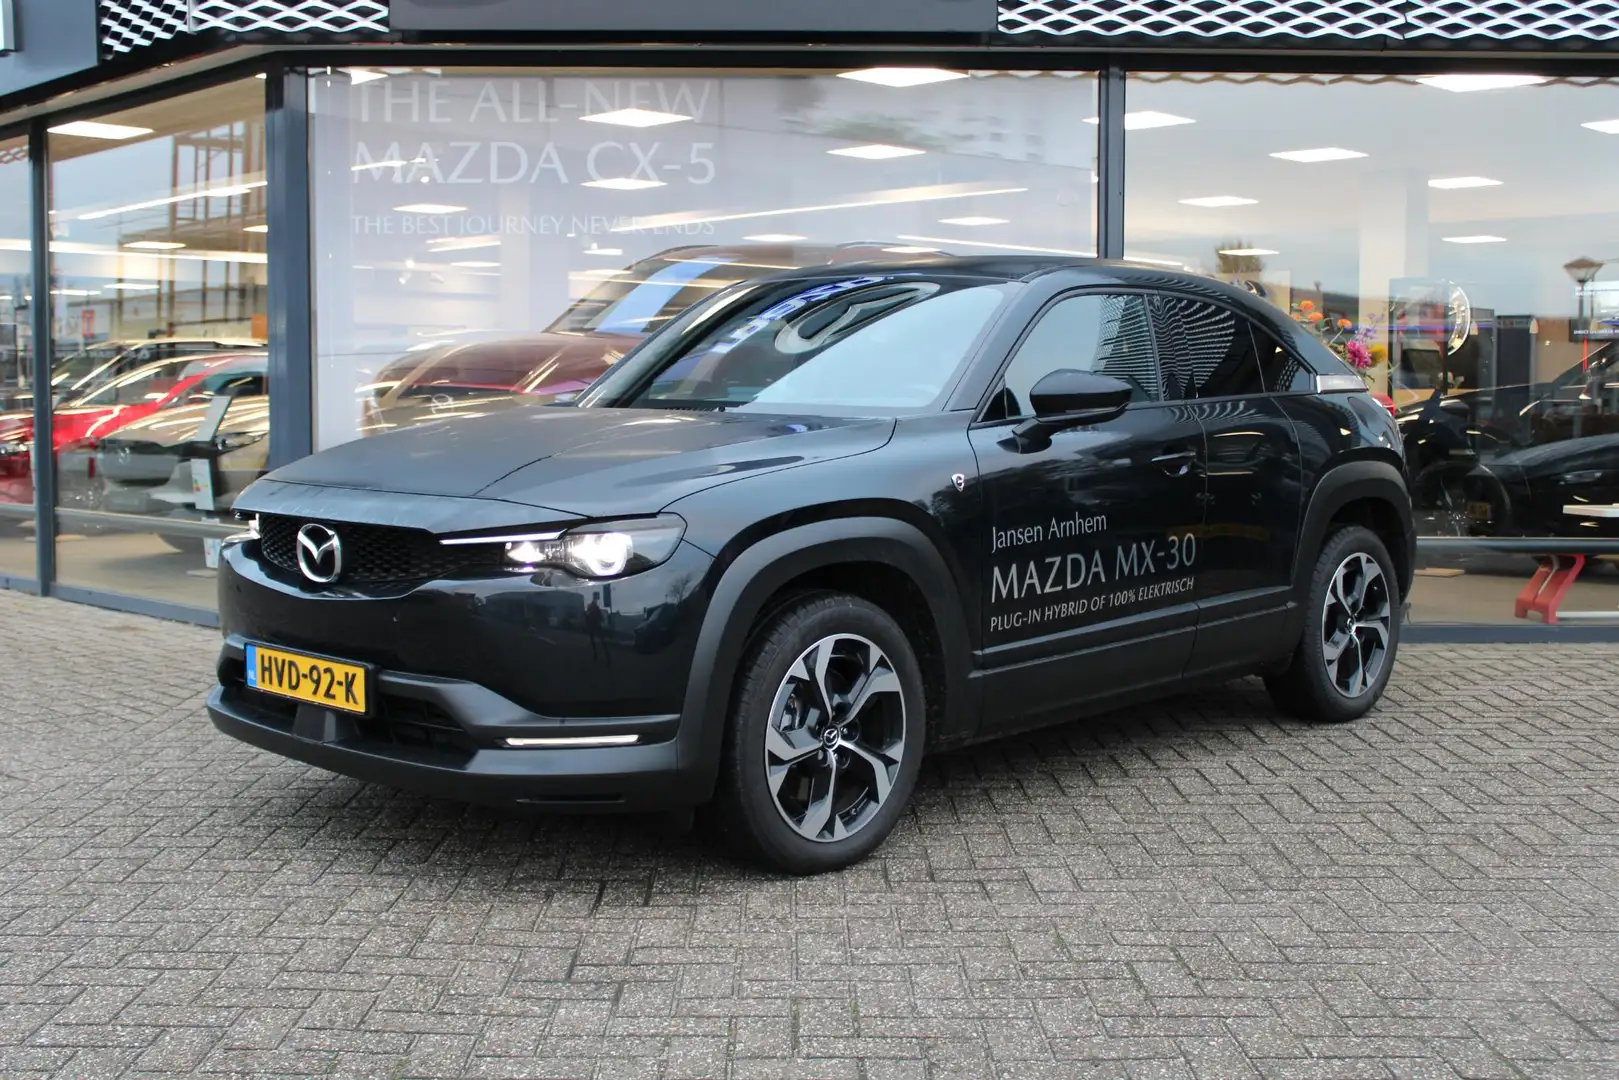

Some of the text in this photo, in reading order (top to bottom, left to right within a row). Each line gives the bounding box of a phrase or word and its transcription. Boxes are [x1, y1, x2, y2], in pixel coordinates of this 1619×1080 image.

[353, 81, 711, 123] THE ALL-NEW
[352, 141, 715, 184] MAZDA CX-5
[352, 215, 393, 234] THE
[403, 215, 452, 234] BEST
[459, 215, 563, 234] JOURNEY
[991, 511, 1107, 553] Jansen Arnhem
[991, 532, 1196, 604] MAZDA MX-30
[990, 576, 1195, 632] PLUG-IN HYBRID OF 100% ELEKTRISCH
[260, 654, 359, 705] HVD-92-K
